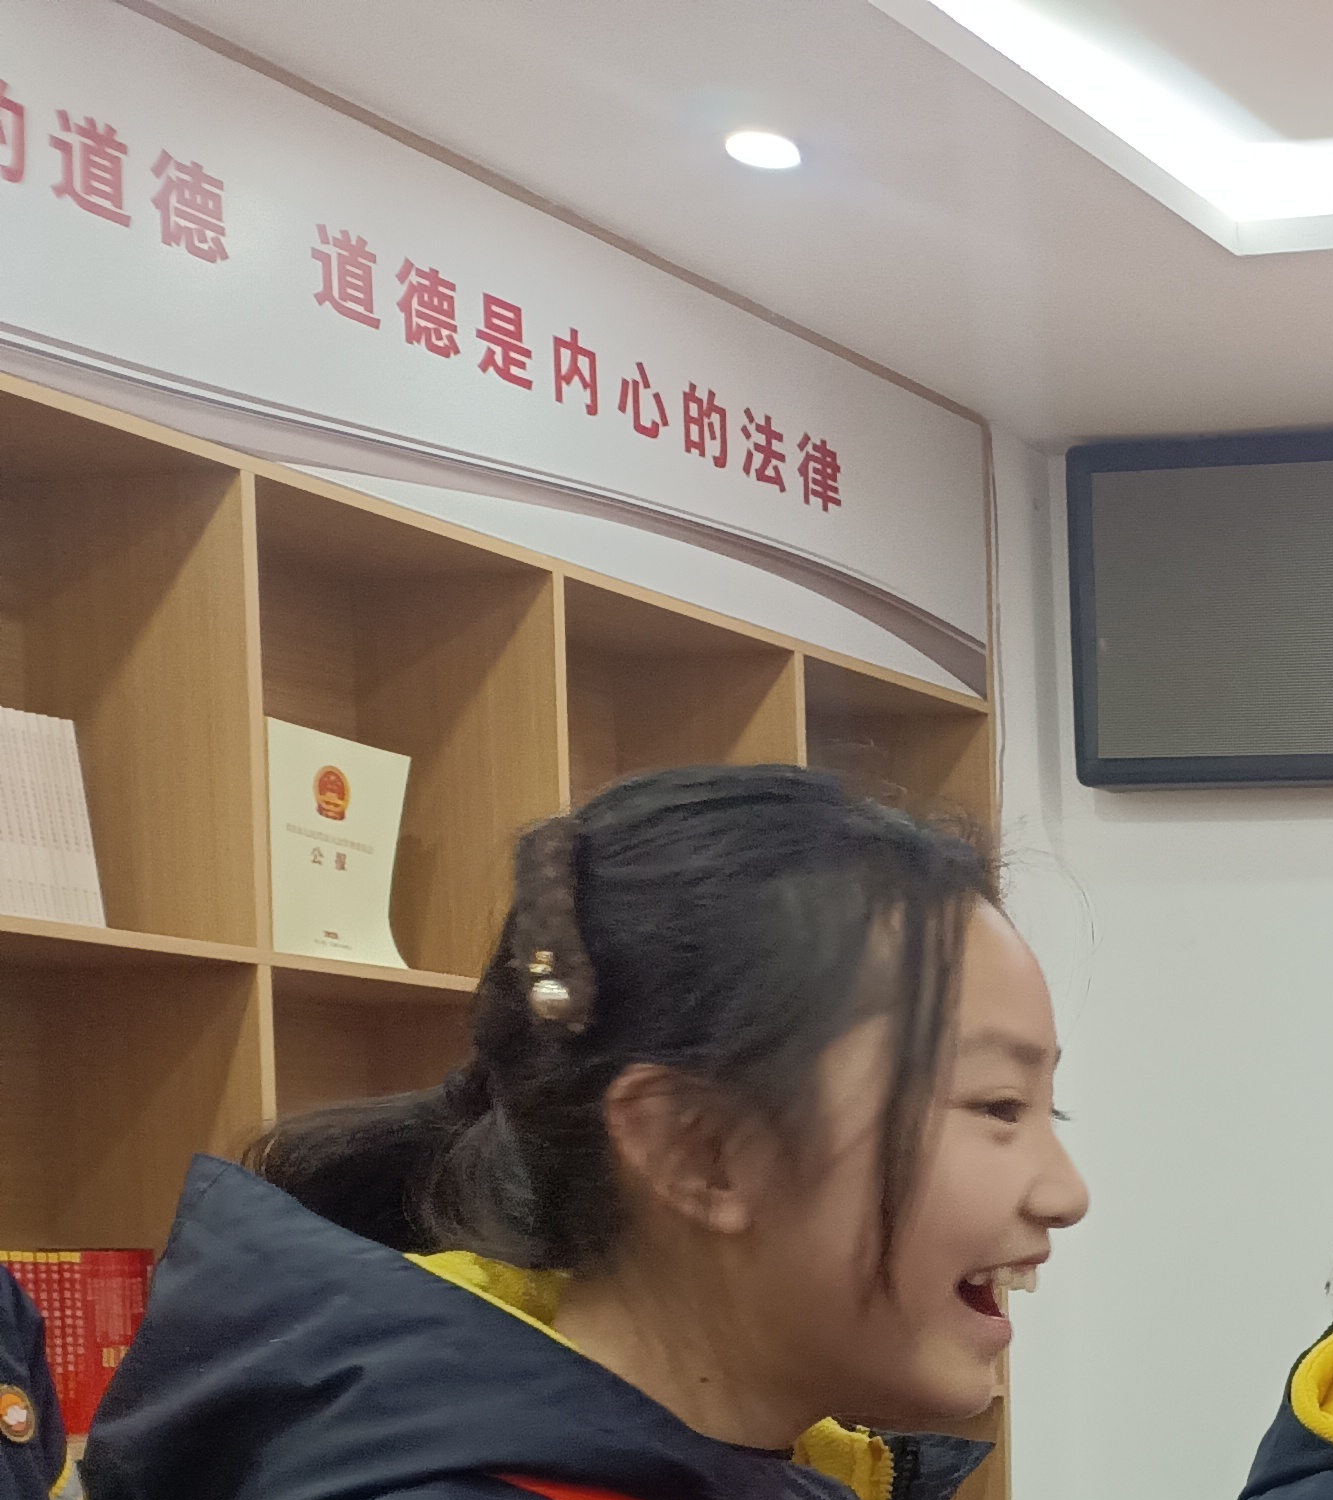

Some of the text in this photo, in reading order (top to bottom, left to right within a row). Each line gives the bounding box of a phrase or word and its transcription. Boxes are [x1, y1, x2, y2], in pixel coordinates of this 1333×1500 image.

[311, 223, 844, 513] 道德是内心的法律
